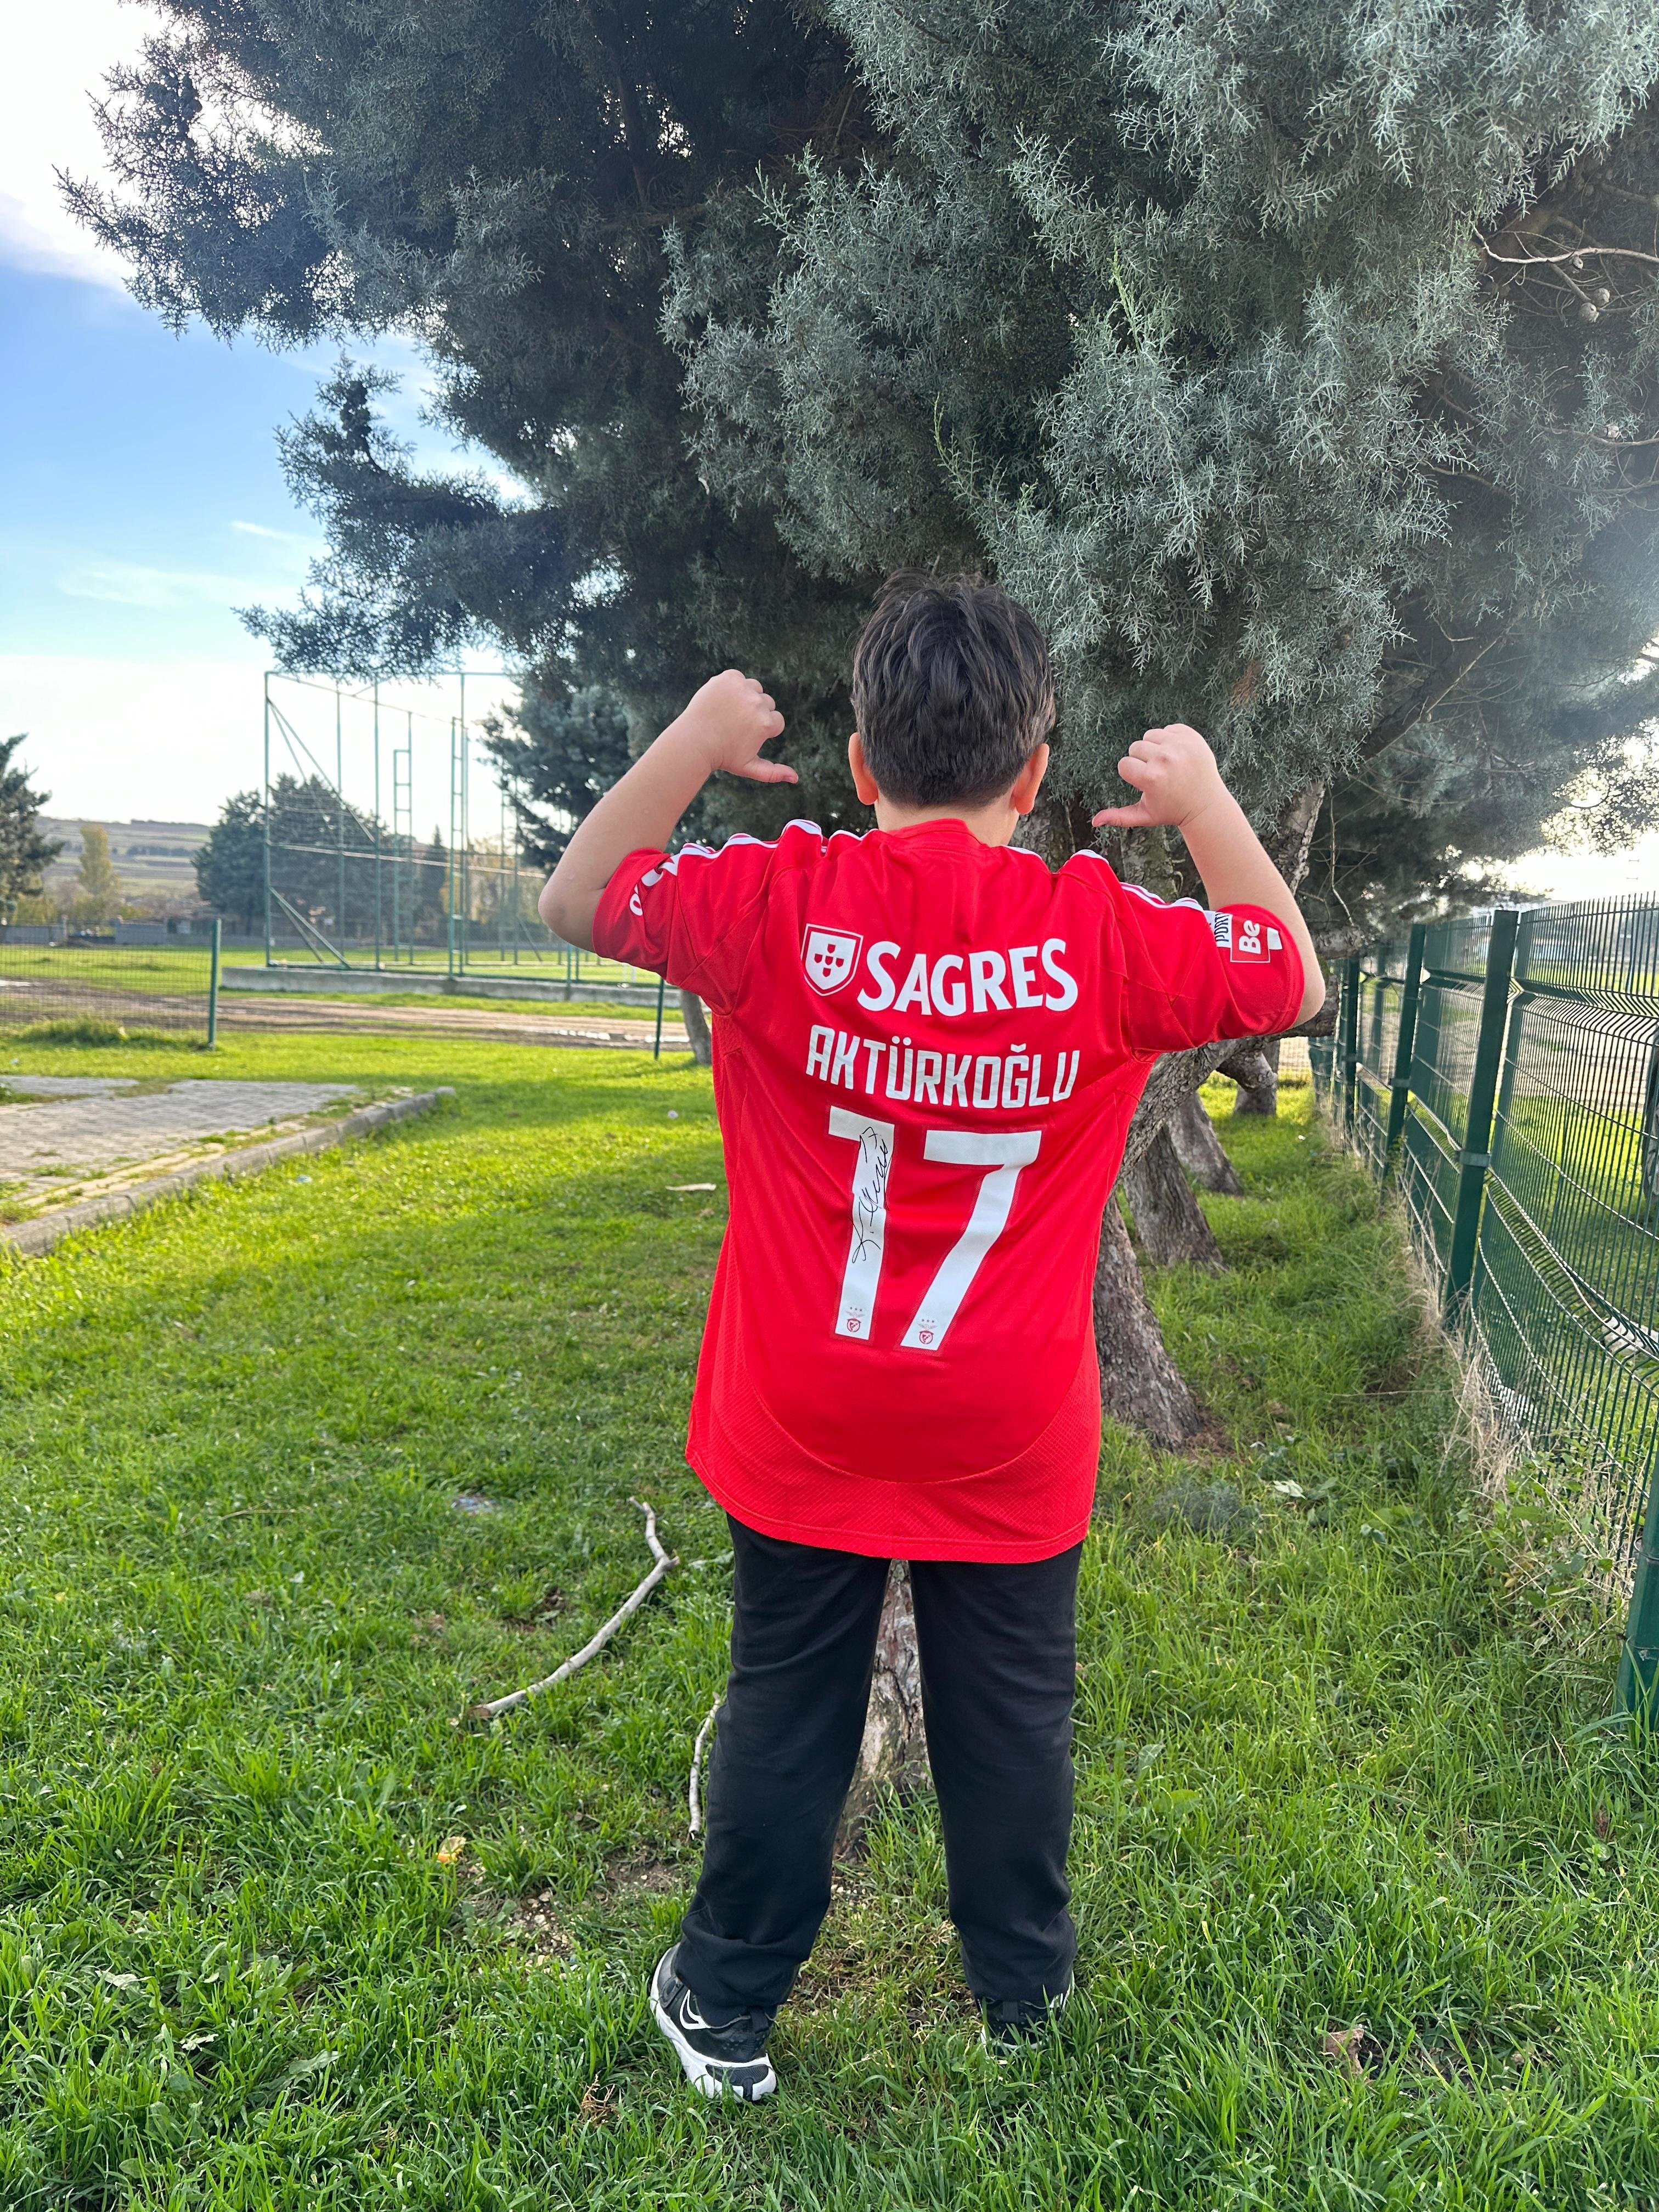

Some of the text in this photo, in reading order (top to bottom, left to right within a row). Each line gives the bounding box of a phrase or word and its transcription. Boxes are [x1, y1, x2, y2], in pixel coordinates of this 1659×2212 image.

[856, 938, 1079, 1017] SAGRES
[1238, 919, 1261, 955] Be
[805, 1024, 1080, 1109] AKTÜRKOĞLU
[828, 1105, 1042, 1351] 17
